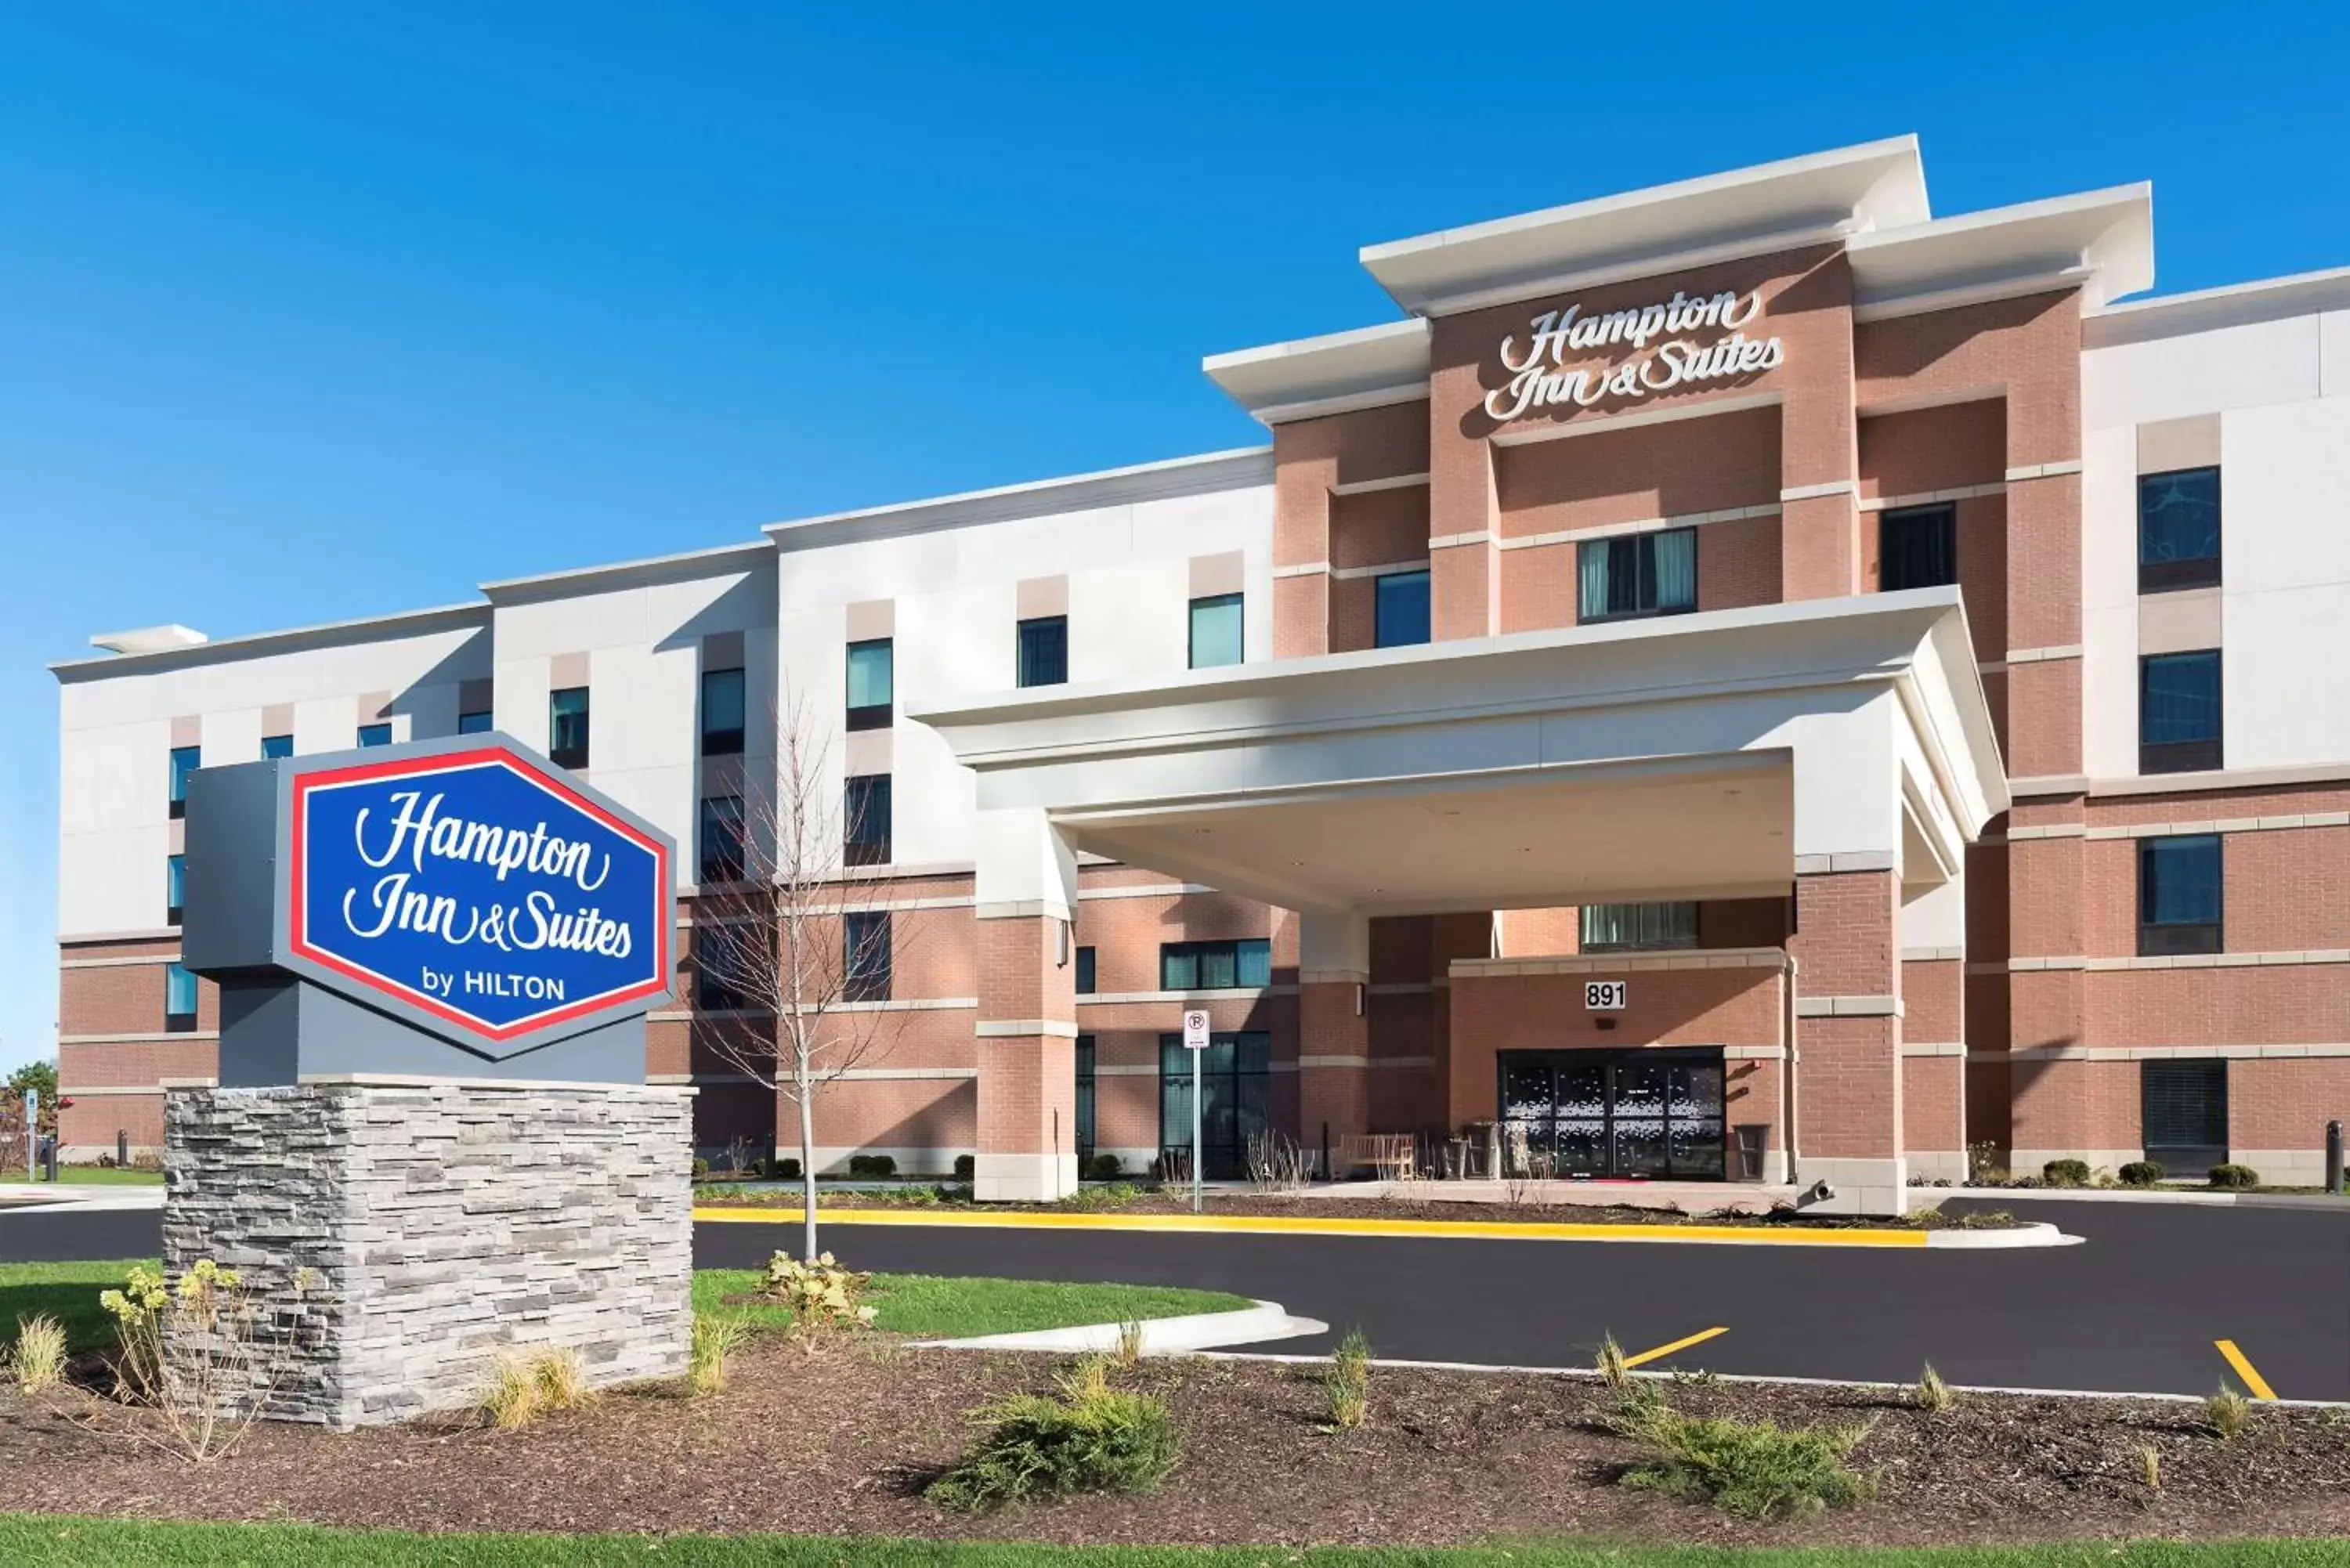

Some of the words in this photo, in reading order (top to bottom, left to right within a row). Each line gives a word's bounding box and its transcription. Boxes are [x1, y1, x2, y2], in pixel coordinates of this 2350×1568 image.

[1500, 291, 1761, 372] Hampton
[1485, 366, 1611, 421] Inn
[1611, 365, 1646, 396] &
[1640, 334, 1784, 389] Suites
[355, 792, 610, 891] Hampton
[342, 873, 479, 945] Inn
[479, 904, 512, 952] &
[508, 891, 632, 959] Suites
[421, 966, 454, 997] by
[465, 970, 565, 1000] HILTON
[1588, 984, 1624, 1006] 891
